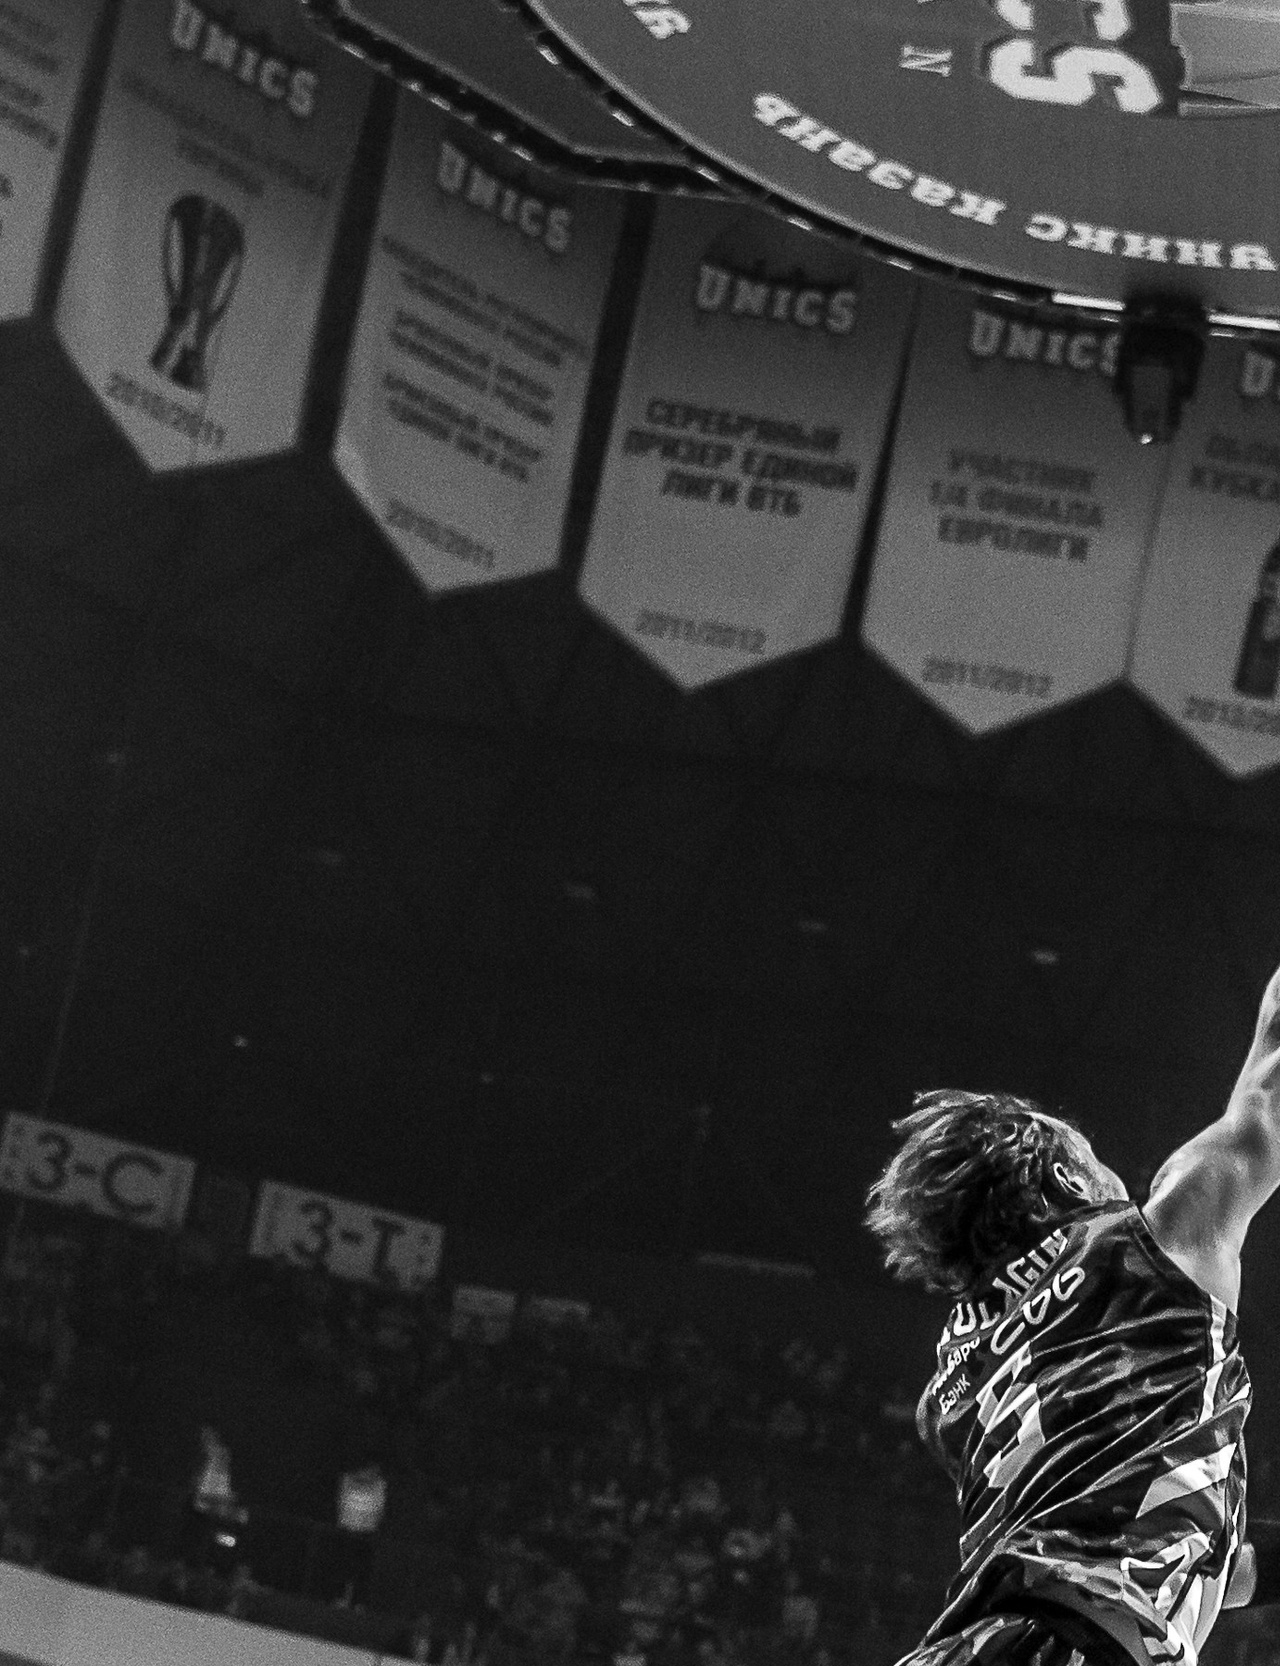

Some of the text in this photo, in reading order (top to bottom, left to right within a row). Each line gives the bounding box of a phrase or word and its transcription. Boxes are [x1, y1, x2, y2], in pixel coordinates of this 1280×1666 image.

[170, 0, 318, 118] UNICS
[437, 141, 571, 253] UNICS
[692, 262, 861, 335] UNICS
